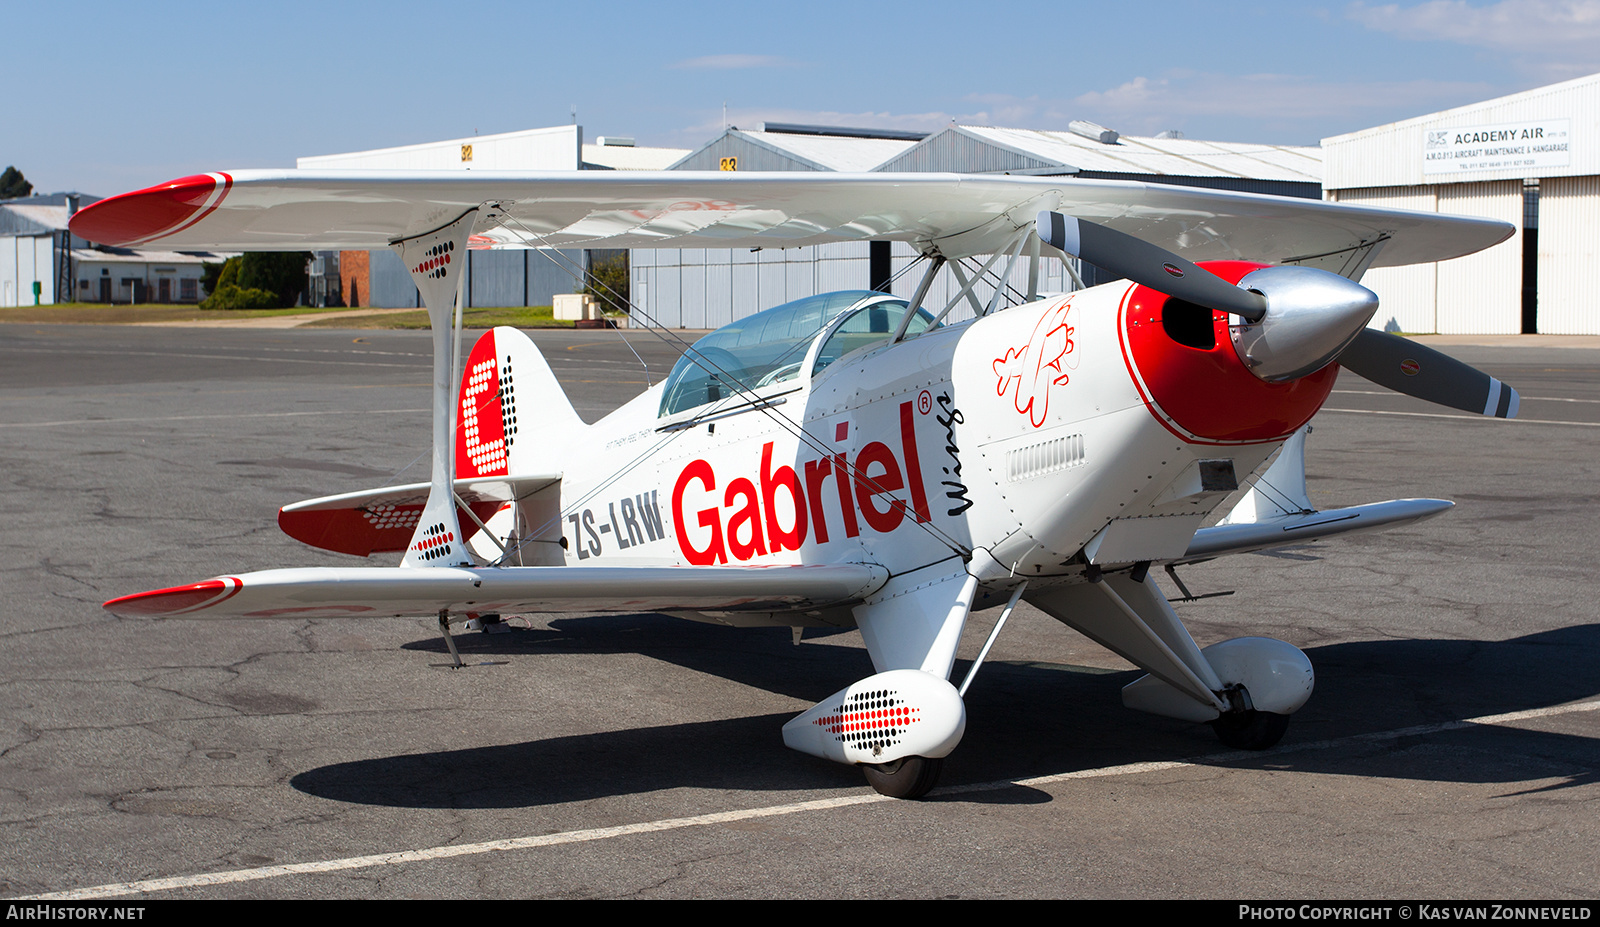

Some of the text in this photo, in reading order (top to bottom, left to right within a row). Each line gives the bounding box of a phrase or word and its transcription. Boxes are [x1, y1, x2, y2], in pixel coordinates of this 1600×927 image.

[1455, 129, 1517, 145] ACADEMY
[1521, 127, 1544, 140] AIR
[461, 145, 472, 161] 32
[1454, 149, 1483, 159] AIRCRAFT
[1484, 146, 1525, 156] MAINTENANCE
[1527, 146, 1532, 154] &
[1533, 143, 1568, 153] HANGARAGE
[721, 158, 736, 172] 33
[936, 391, 973, 516] Wings
[672, 400, 931, 566] Gabriel
[569, 489, 665, 560] ZS-LRW
